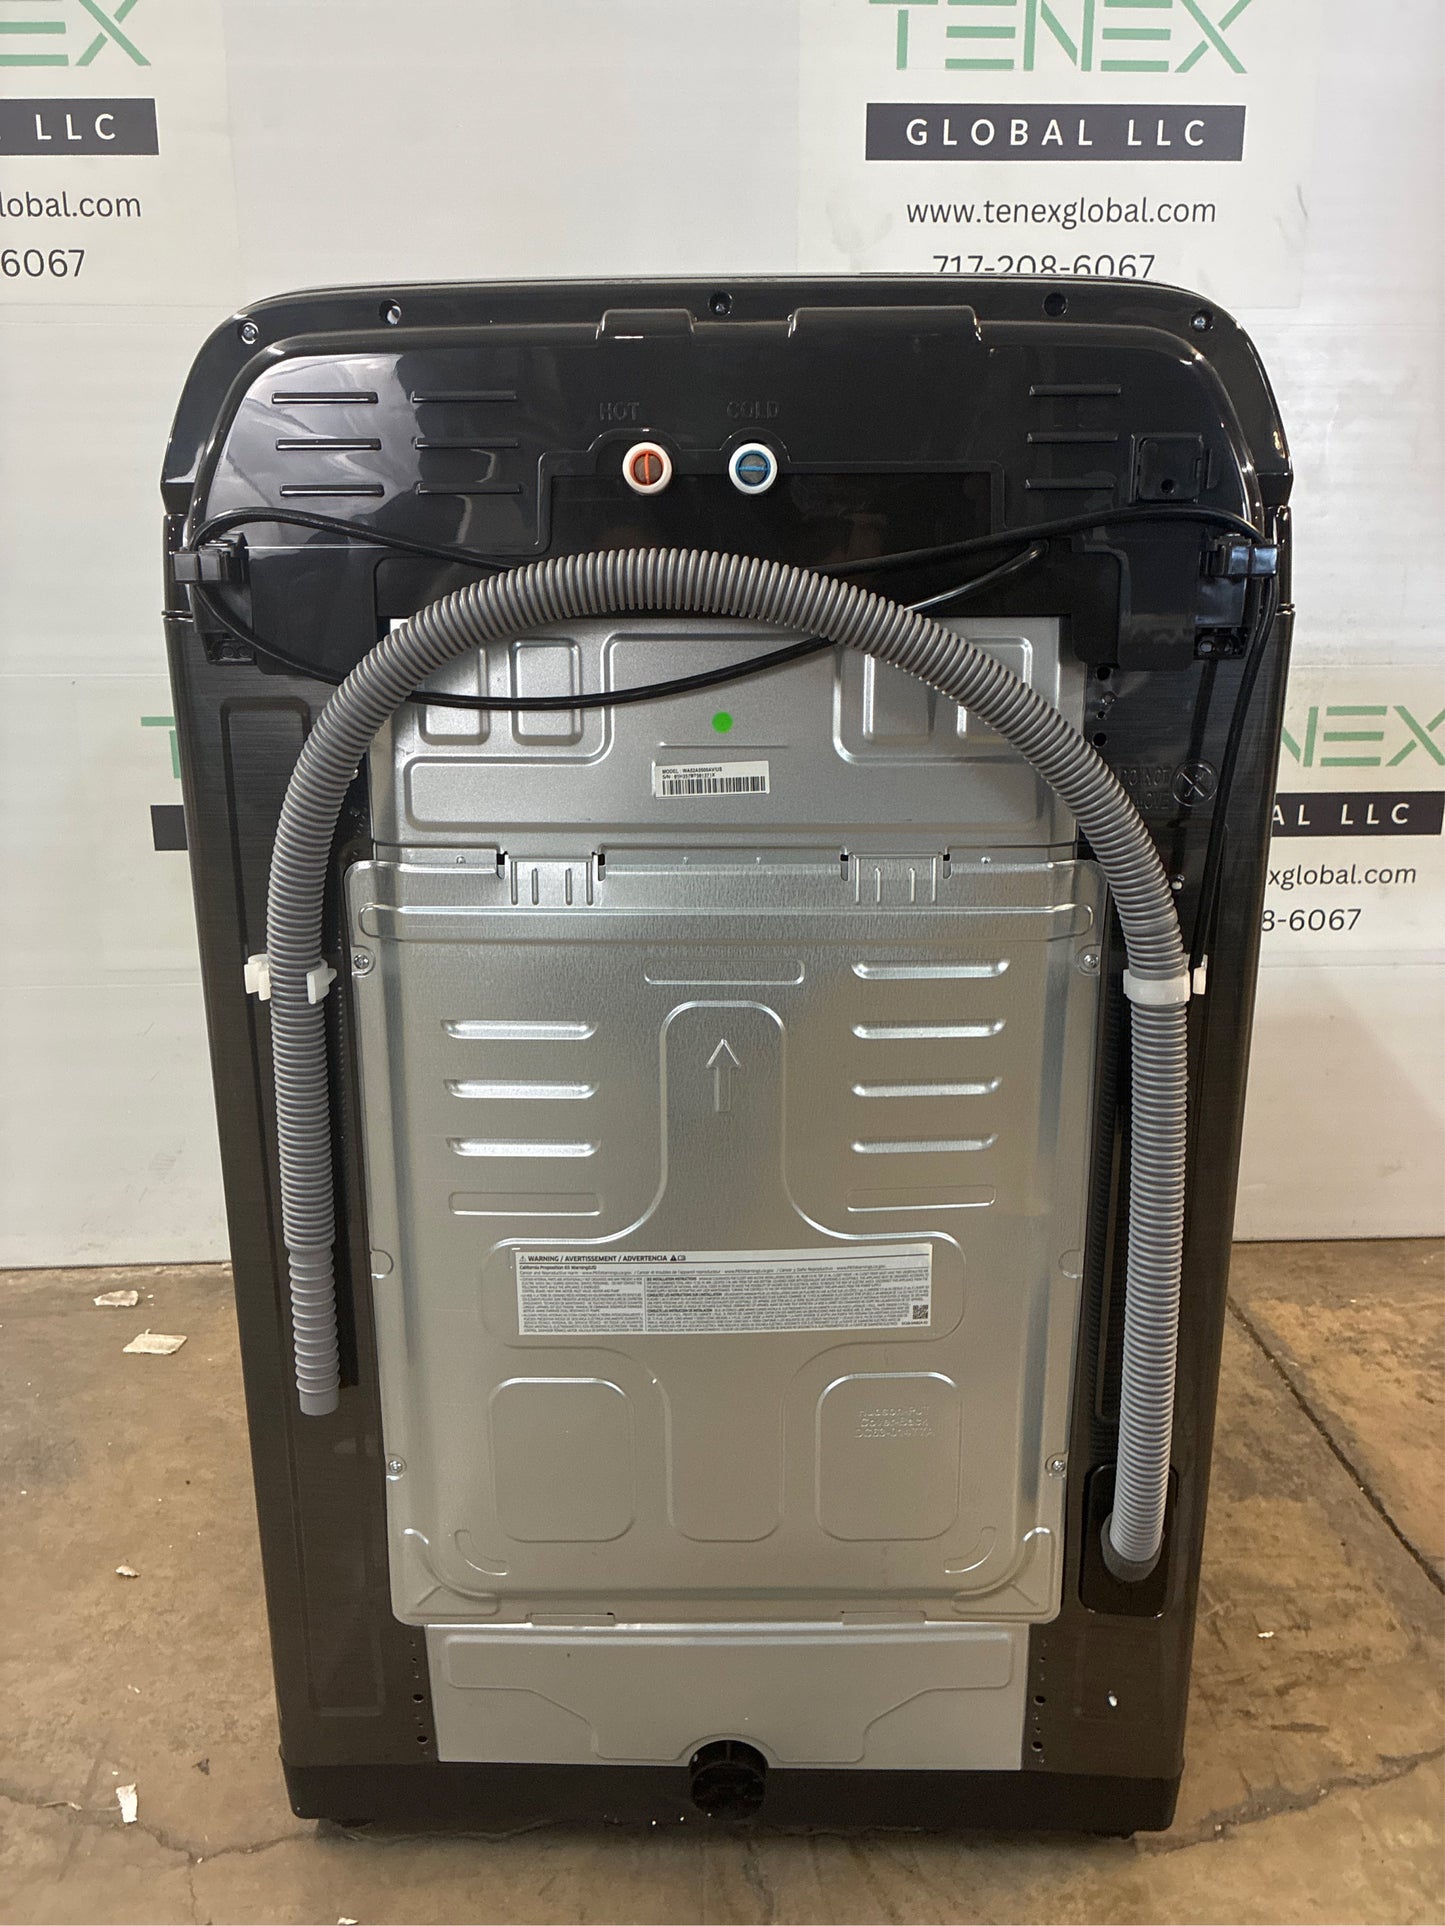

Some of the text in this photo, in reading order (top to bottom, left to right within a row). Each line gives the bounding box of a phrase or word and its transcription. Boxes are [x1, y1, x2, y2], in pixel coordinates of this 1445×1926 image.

[869, 0, 1251, 73] TENEX
[35, 114, 116, 140] LLC
[906, 118, 1206, 147] GLOBAL LLC
[906, 197, 1216, 229] www.tenexglobal.com
[933, 254, 1155, 278] 717-208-6067
[600, 402, 640, 421] HOT
[726, 401, 780, 419] COLD
[1340, 803, 1410, 826] LLC
[1268, 864, 1416, 891] xglobal.com
